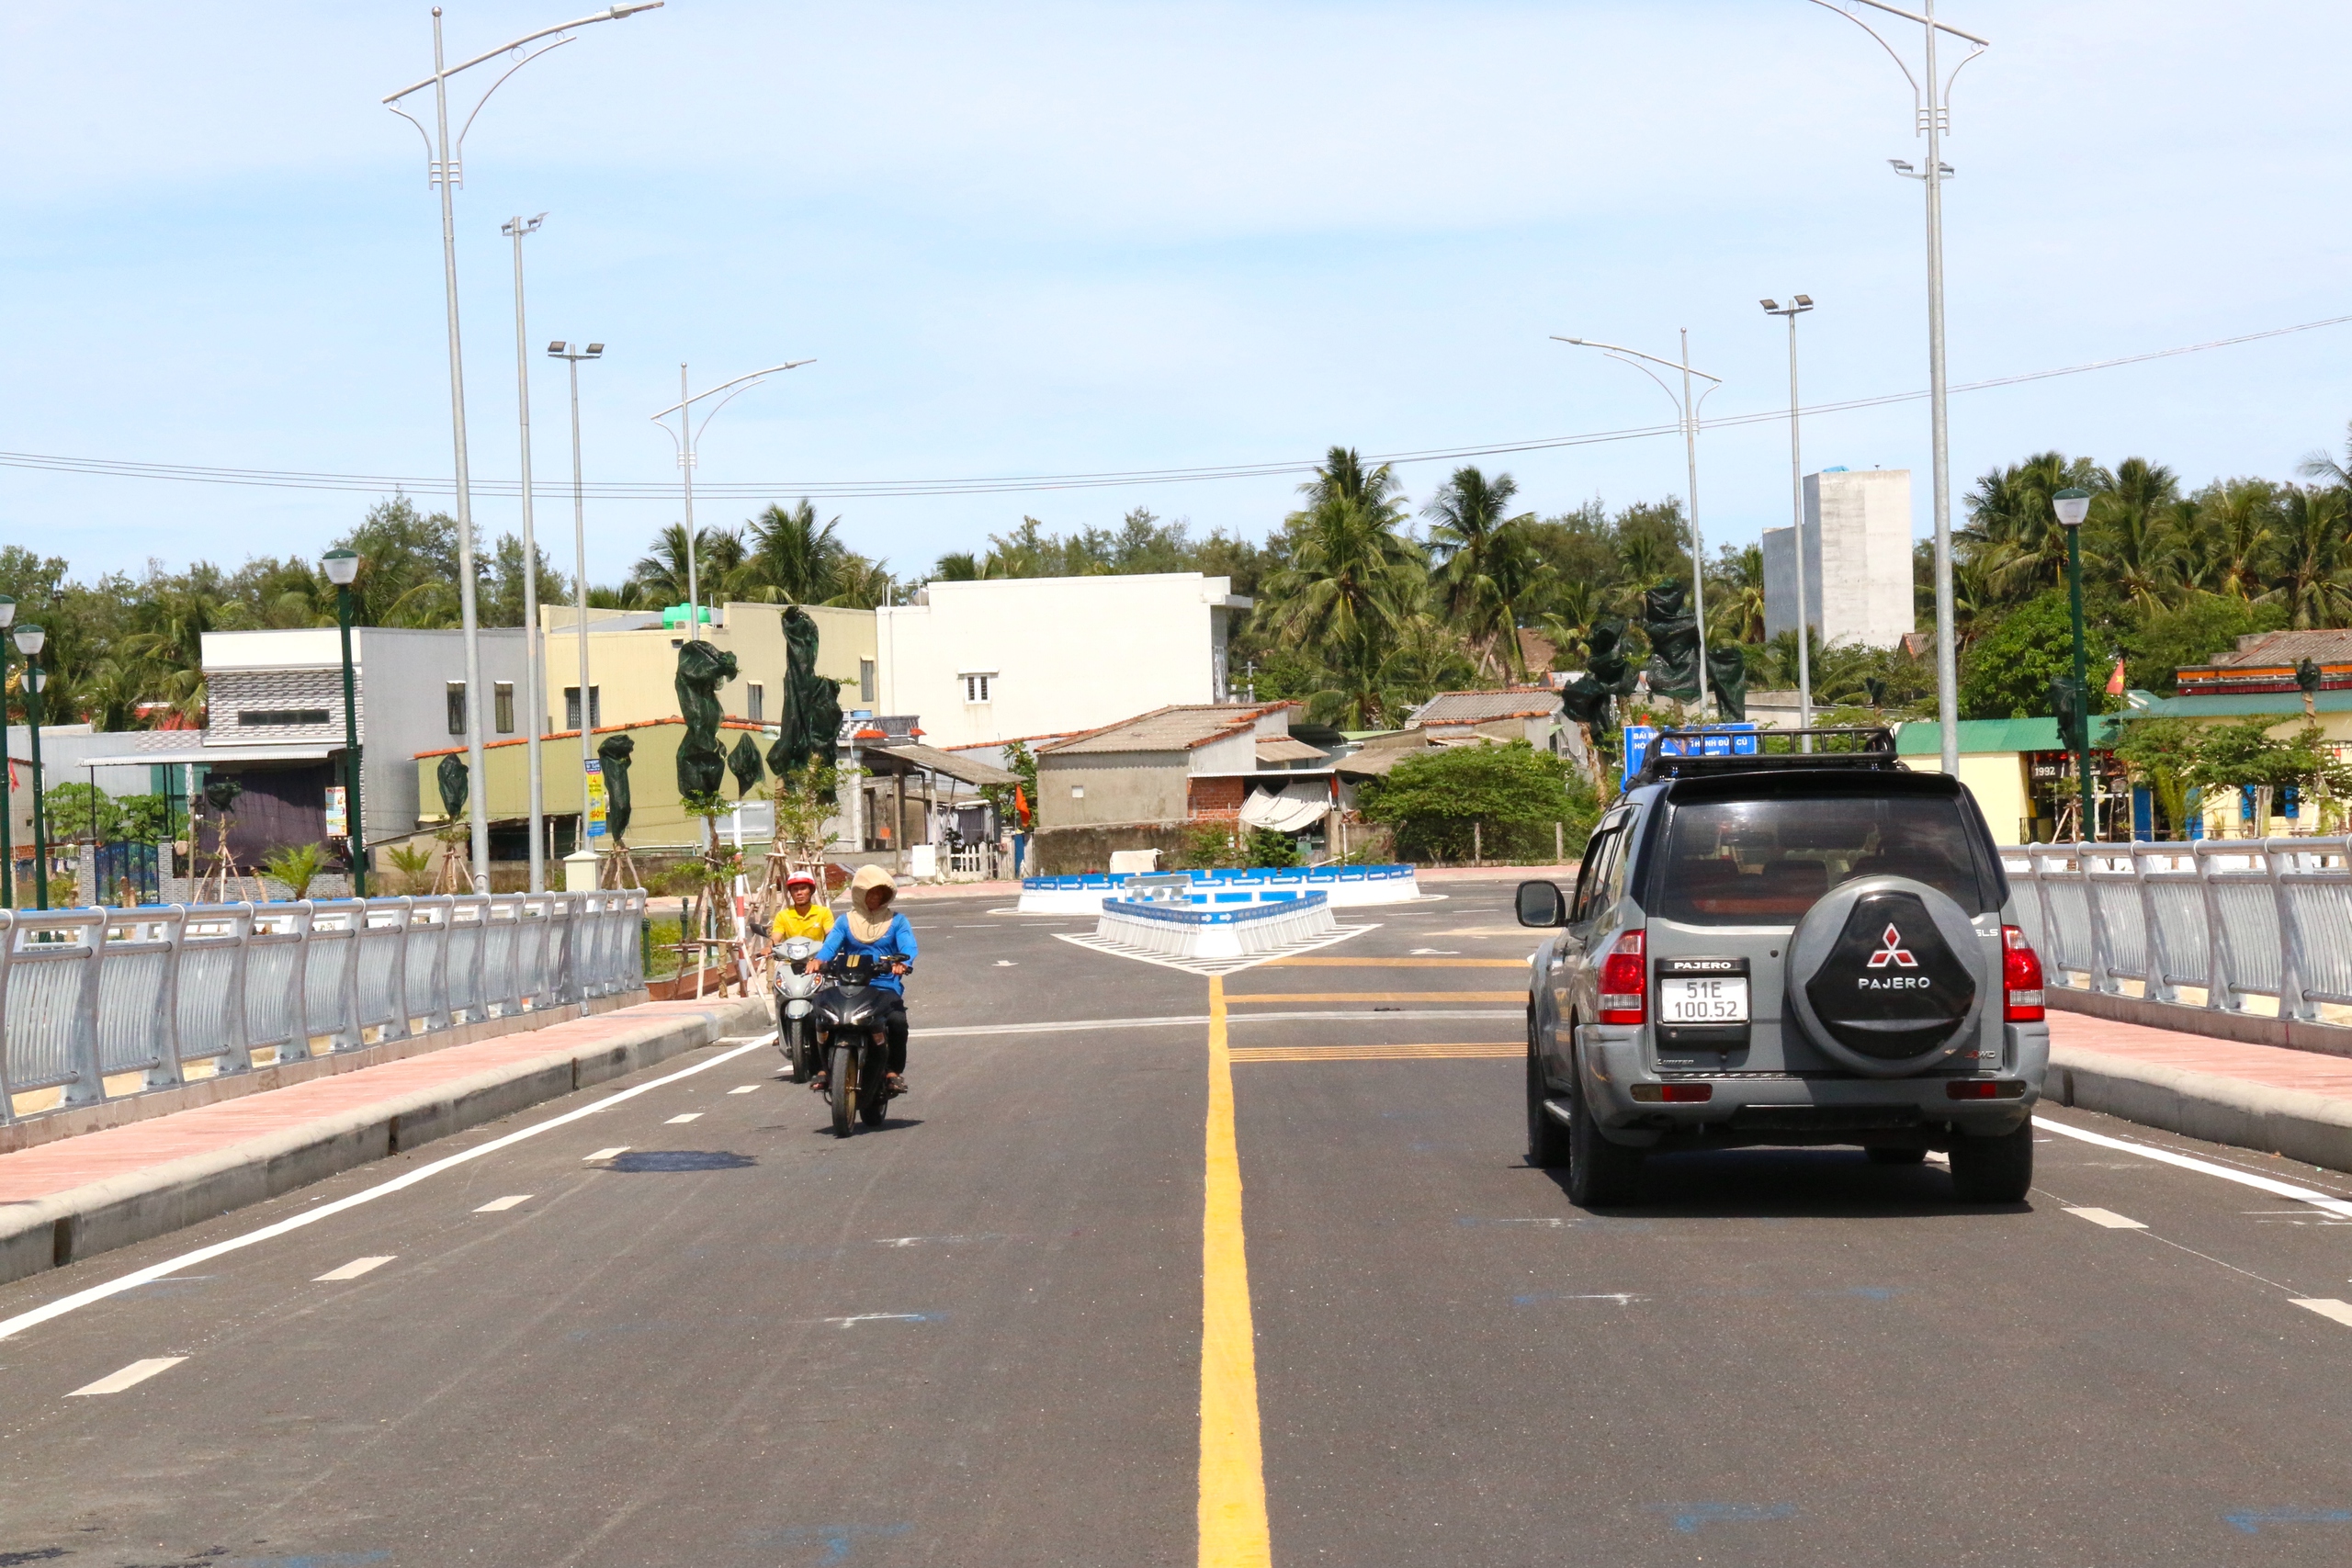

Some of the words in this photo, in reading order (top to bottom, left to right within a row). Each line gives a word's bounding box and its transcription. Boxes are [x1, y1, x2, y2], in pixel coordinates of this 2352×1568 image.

[2035, 766, 2055, 776] 1992
[1686, 981, 1723, 998] 51E
[1858, 977, 1930, 989] PAJERO
[1675, 1000, 1738, 1019] 100.52
